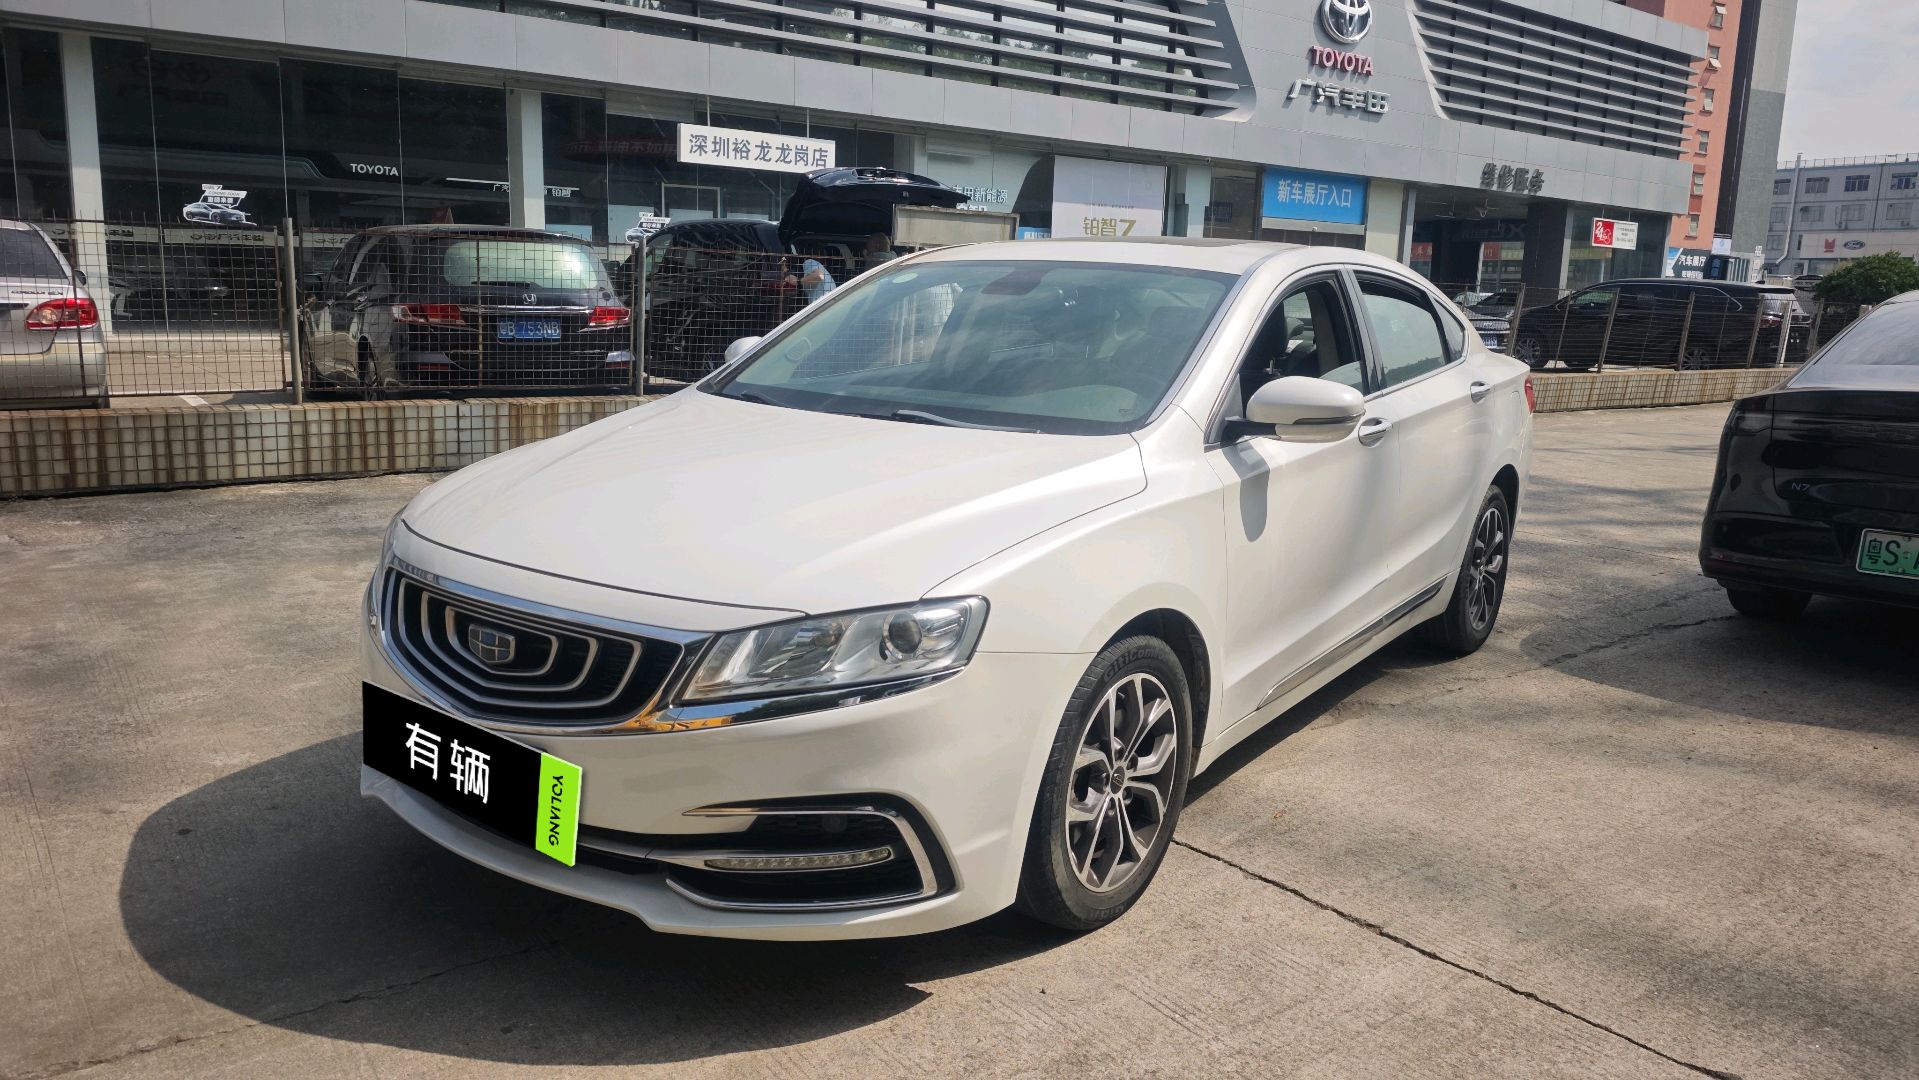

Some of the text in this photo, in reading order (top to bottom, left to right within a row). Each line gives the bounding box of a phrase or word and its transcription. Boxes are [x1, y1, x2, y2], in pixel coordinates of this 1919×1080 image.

[1312, 45, 1374, 76] TOYOTA
[1288, 78, 1391, 114] 广汽丰田
[688, 133, 829, 169] 深圳裕龙龙岗店
[350, 163, 399, 176] TOYOTA
[1277, 178, 1352, 208] 新车展厅入口
[1678, 255, 1707, 267] 汽车展厅
[1865, 538, 1918, 570] 粤S
